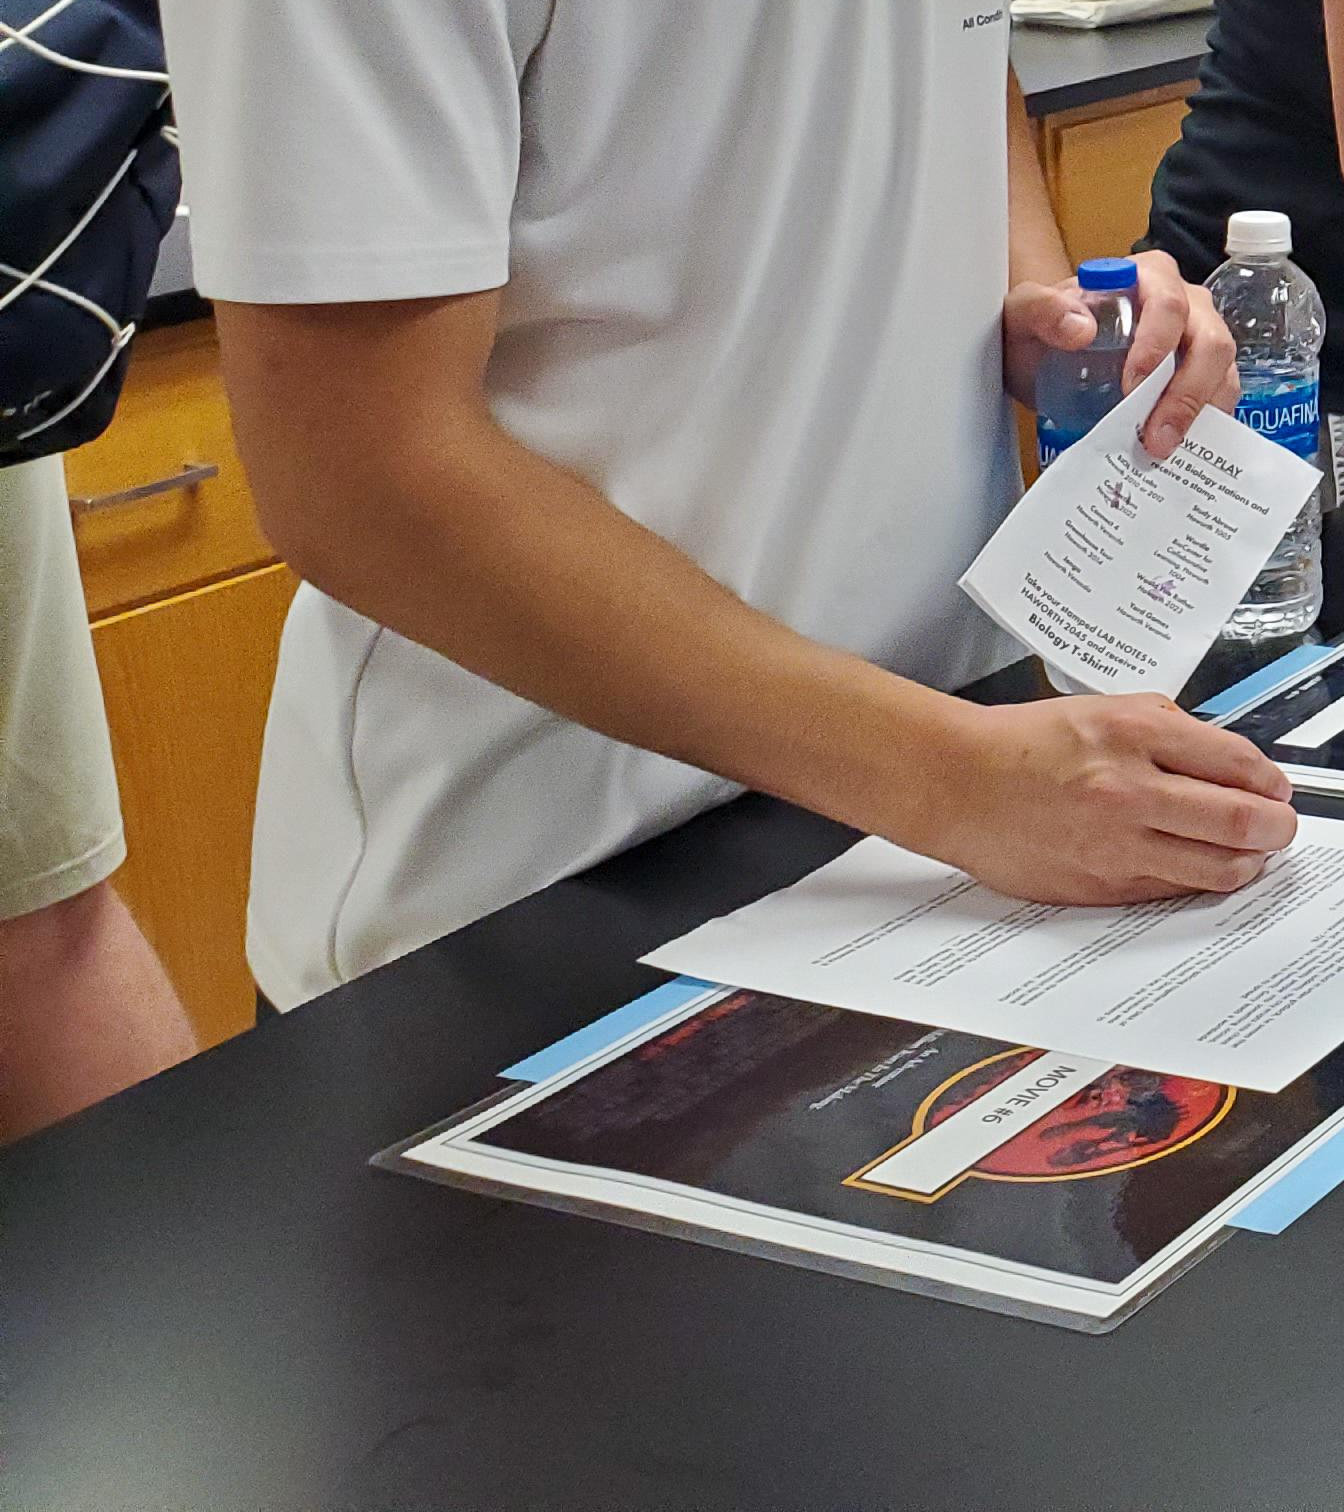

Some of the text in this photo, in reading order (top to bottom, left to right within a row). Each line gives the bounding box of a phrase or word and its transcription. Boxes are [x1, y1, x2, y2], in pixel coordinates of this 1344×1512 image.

[963, 16, 974, 31] All
[1235, 395, 1319, 434] AQUAFINA
[1149, 458, 1181, 481] receive
[1189, 483, 1215, 501] stamp.
[1197, 446, 1214, 462] TO
[1213, 456, 1243, 478] PLAY
[1170, 455, 1270, 515] (4) Biology stations and
[1192, 505, 1238, 533] Study Abroad
[1021, 587, 1069, 625] HAWORTH
[1063, 622, 1087, 642] 2045
[1087, 640, 1106, 654] and
[1105, 651, 1137, 671] receive
[1025, 572, 1157, 667] Take your stamped LAB NOTES to
[1028, 613, 1070, 650] Biology
[982, 1064, 1077, 1124] MOVIE #6
